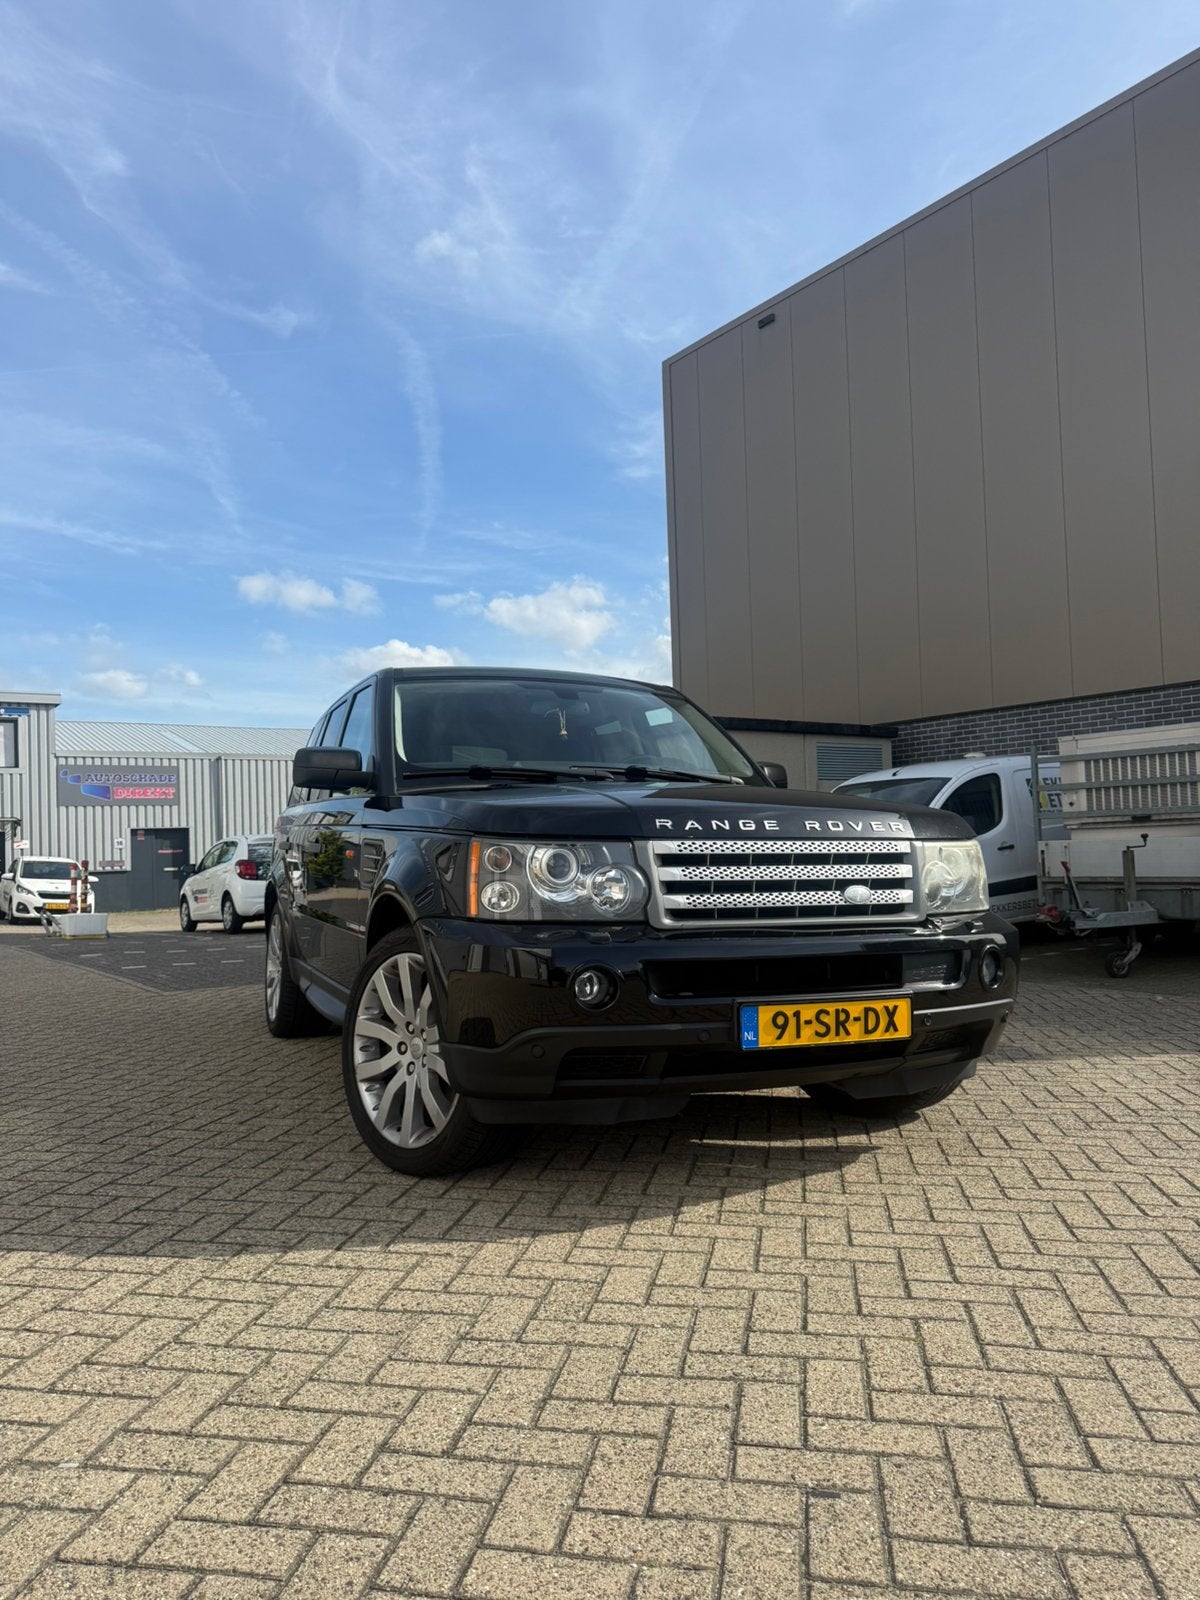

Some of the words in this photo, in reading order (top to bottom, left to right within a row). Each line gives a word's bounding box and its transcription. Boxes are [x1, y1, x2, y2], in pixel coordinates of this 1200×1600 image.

[85, 773, 177, 783] AUTOSCHADE
[113, 786, 175, 799] DIREKT
[655, 818, 780, 831] RANGE
[804, 820, 906, 832] ROVER
[989, 899, 1040, 913] EKKERSBET
[771, 1004, 899, 1041] 91-SR-DX
[743, 1031, 757, 1041] NL
